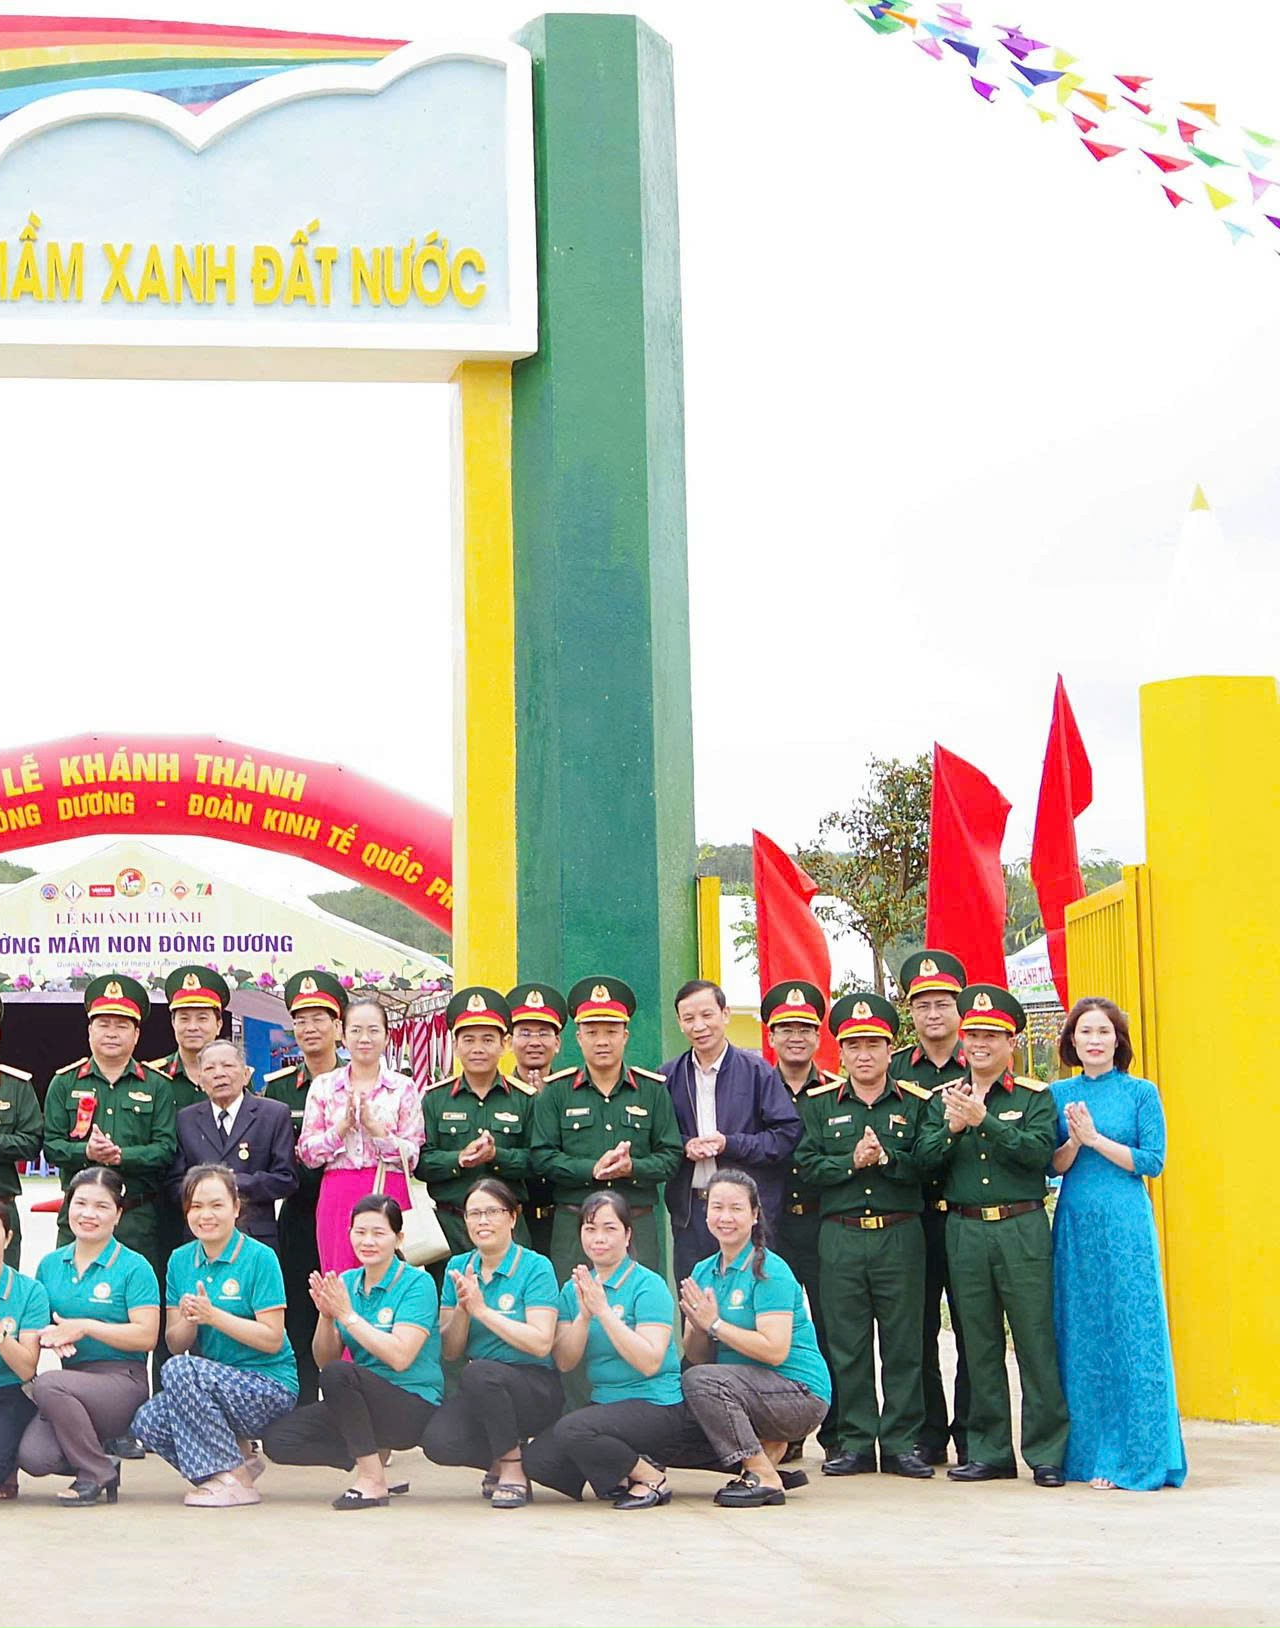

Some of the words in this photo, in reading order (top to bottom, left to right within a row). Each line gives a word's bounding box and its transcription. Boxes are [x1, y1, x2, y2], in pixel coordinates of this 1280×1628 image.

[101, 242, 237, 304] XANH
[249, 219, 339, 305] ĐẤT
[351, 230, 487, 308] NƯỚC
[1, 753, 44, 798] LỄ
[59, 746, 180, 787] KHÁNH
[194, 753, 307, 803] THÀNH
[57, 790, 135, 820] DƯƠNG
[188, 793, 253, 825] ĐOÀN
[262, 807, 321, 841] KINH
[327, 823, 359, 855] TẾ
[361, 843, 424, 884] QUỐC
[48, 930, 100, 953] MẦM
[108, 936, 151, 953] NON
[159, 932, 215, 953] ĐÔNG
[222, 934, 293, 953] DƯƠNG
[82, 908, 139, 924] KHÁNH
